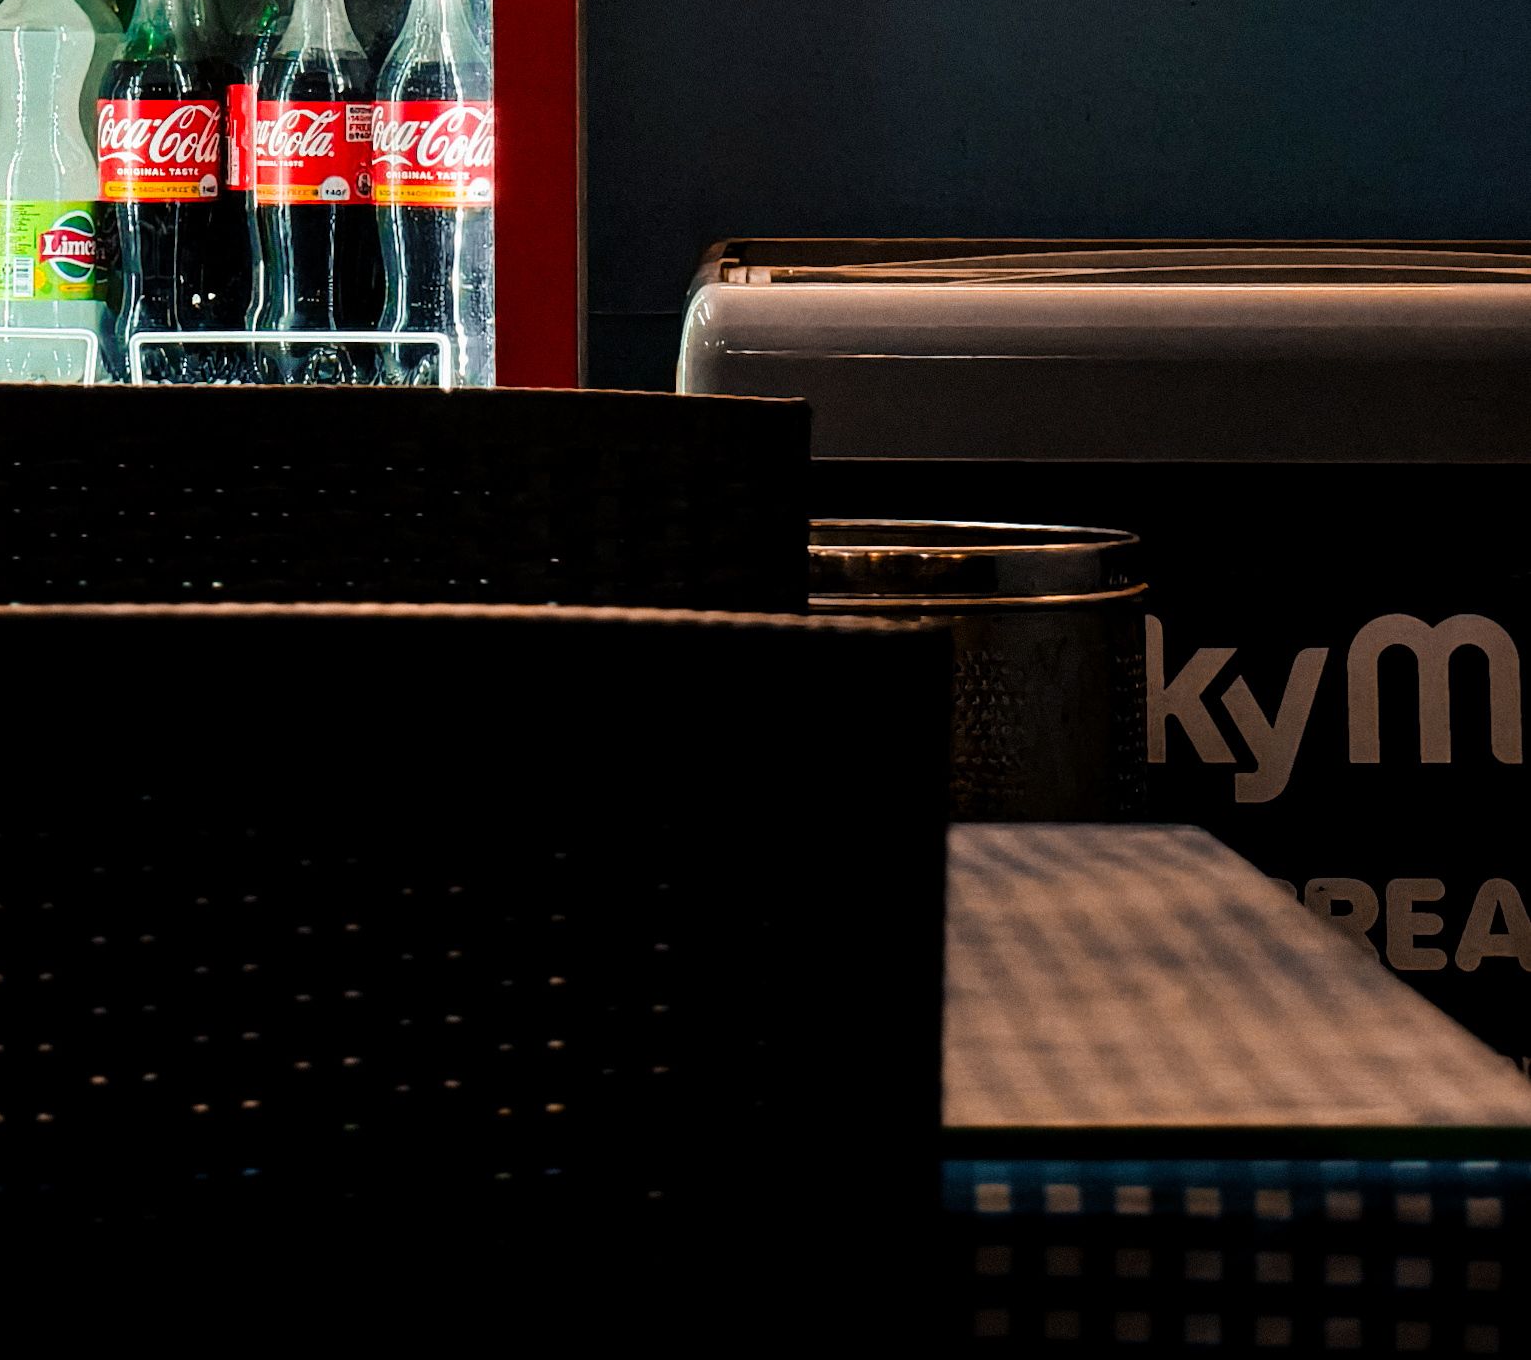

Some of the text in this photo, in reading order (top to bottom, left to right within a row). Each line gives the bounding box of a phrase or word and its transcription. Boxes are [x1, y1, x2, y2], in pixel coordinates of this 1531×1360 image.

[99, 103, 220, 164] Coca-Cola
[373, 106, 493, 167] Coca-Cola
[116, 167, 200, 177] ORIGINAL TASTE
[385, 170, 434, 180] ORIGINAL
